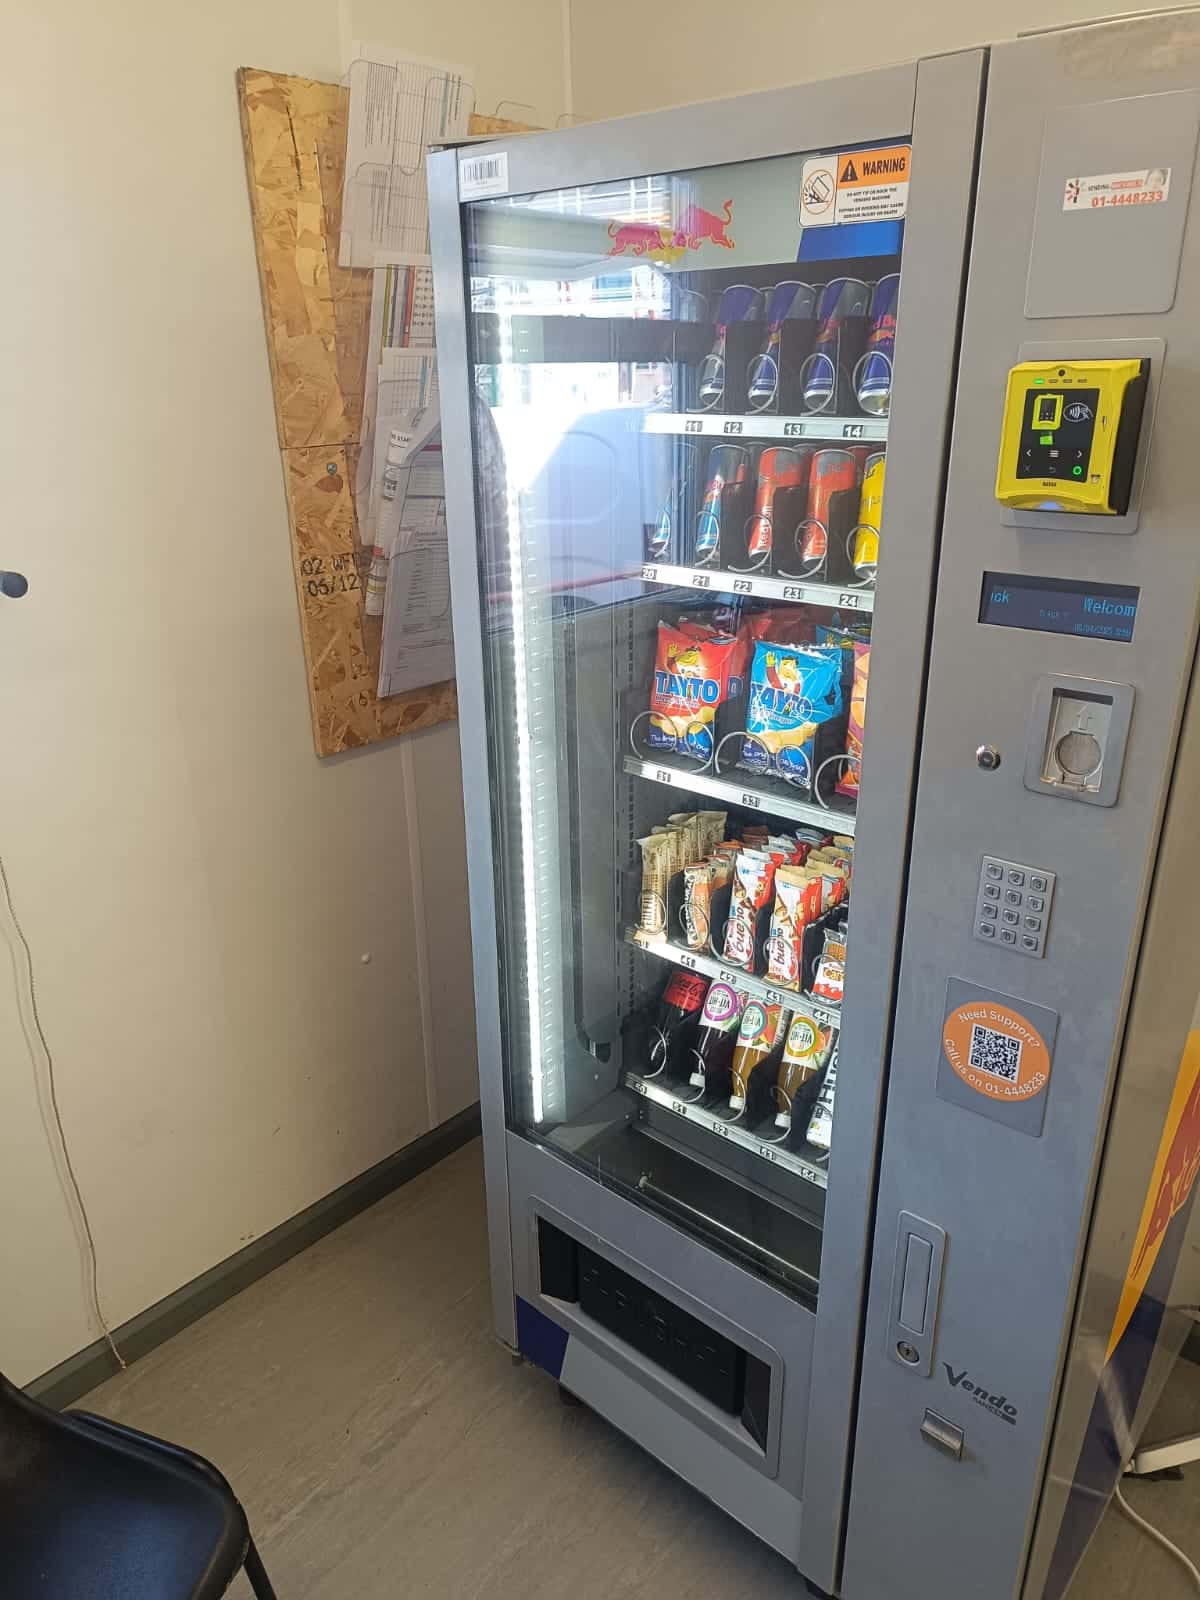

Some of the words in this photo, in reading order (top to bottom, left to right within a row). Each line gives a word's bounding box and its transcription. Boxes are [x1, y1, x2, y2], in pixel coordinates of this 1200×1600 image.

[862, 157, 906, 177] WARNING
[1091, 190, 1164, 208] 01-4448233
[685, 421, 700, 431] 11
[725, 422, 741, 433] 12
[785, 424, 801, 435] 13
[845, 426, 862, 437] 14
[643, 570, 655, 579] 20
[693, 576, 707, 586] 21
[735, 581, 750, 591] 22
[784, 588, 800, 599] 23
[841, 595, 858, 606] 24
[655, 672, 720, 704] TAYTO
[750, 681, 813, 722] TAYTO
[814, 1011, 829, 1021] 44
[957, 1008, 987, 1023] Need
[989, 1010, 1041, 1048] Support?
[945, 1038, 960, 1063] Call
[956, 1061, 968, 1075] us
[968, 1074, 983, 1087] on
[985, 1071, 1046, 1096] 01-4448233
[942, 1361, 1018, 1416] Vendo
